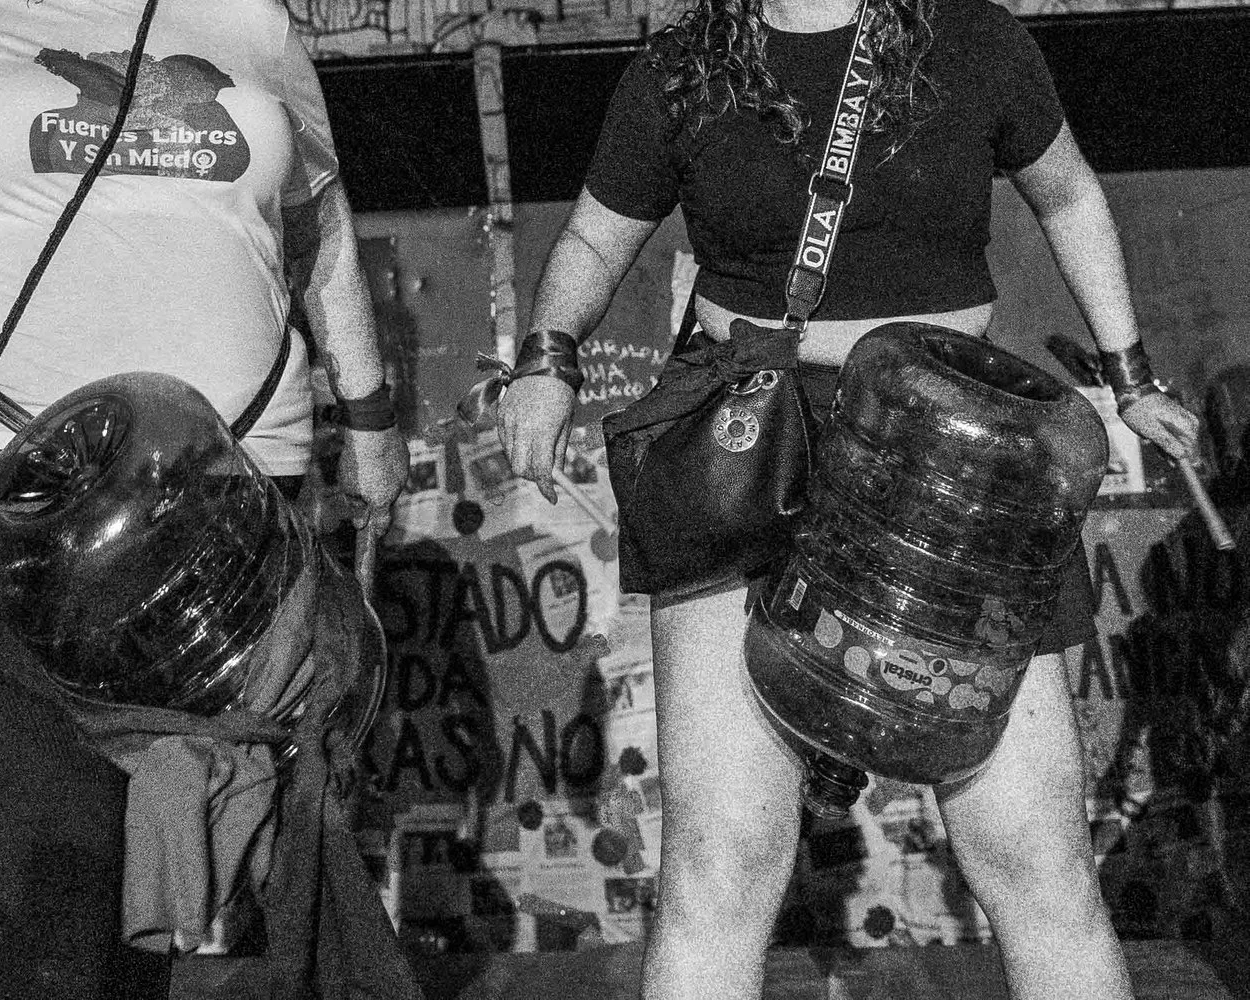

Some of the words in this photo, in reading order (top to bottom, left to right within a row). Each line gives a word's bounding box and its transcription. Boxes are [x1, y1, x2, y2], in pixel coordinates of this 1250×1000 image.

[41, 112, 138, 143] Fuerts
[151, 128, 237, 146] Libres
[59, 140, 77, 161] Y
[84, 144, 121, 166] Sn
[802, 209, 837, 268] OLA
[884, 661, 932, 687] cristal
[505, 710, 604, 800] NO
